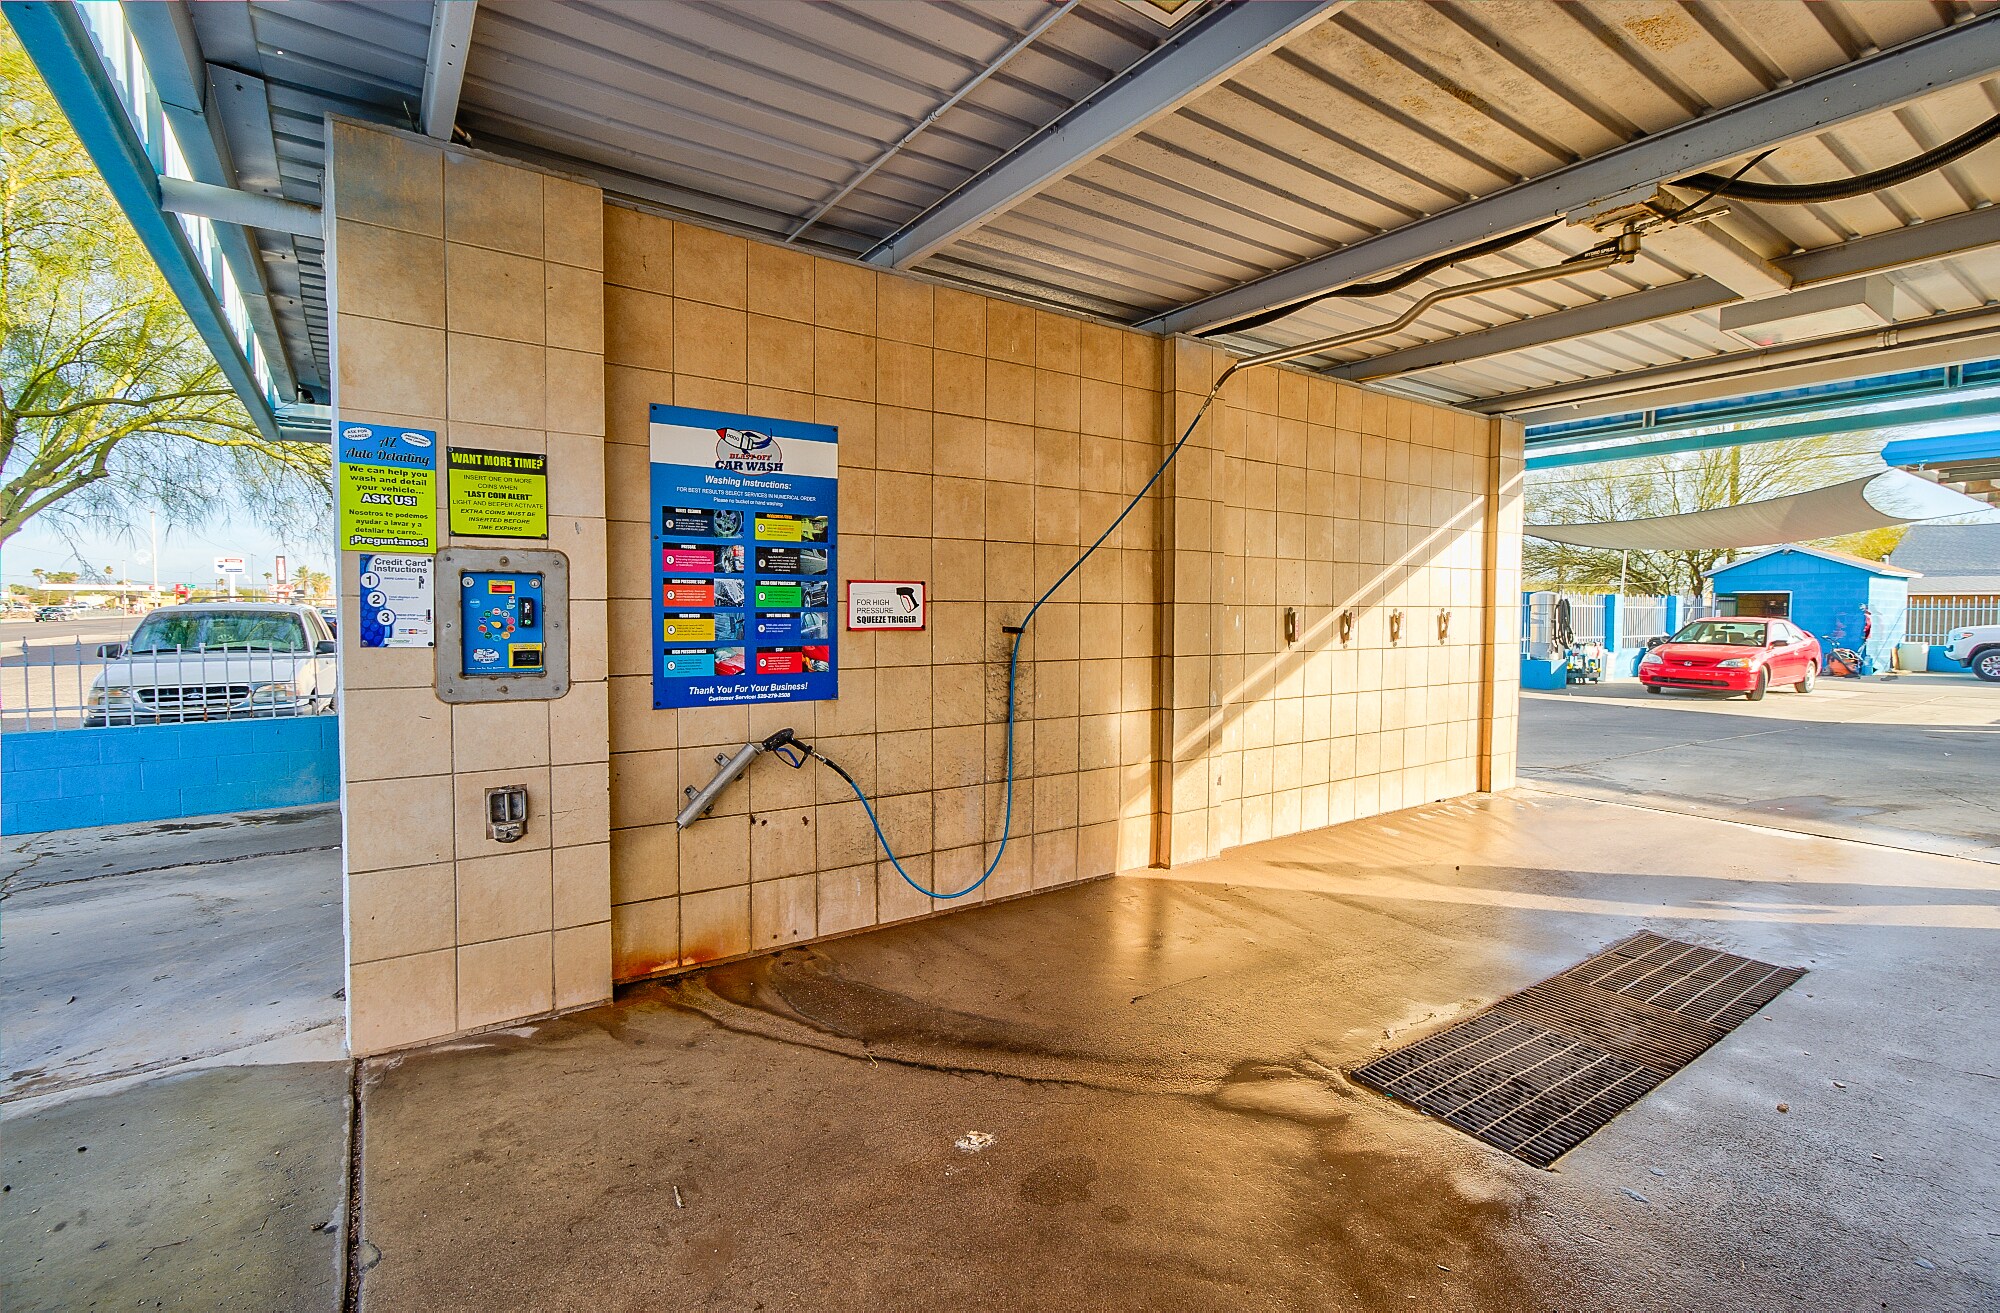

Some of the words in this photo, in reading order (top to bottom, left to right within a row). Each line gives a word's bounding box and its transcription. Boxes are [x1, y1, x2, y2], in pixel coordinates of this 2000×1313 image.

[345, 447, 373, 459] Auto
[377, 449, 430, 466] Detailing
[451, 452, 482, 465] WANT
[484, 455, 513, 467] MORE
[513, 458, 544, 470] TIME?
[715, 460, 743, 470] CAR
[746, 461, 784, 472] WASH
[388, 469, 408, 477] help
[705, 474, 741, 487] Washing
[742, 478, 792, 490] Instructions:
[382, 486, 424, 494] vehicle...
[744, 491, 768, 499] SERVICES
[361, 493, 392, 505] ASK
[393, 495, 417, 506] US!
[349, 509, 384, 517] Nosotros
[350, 535, 429, 547] ¡Preguntanos!
[375, 557, 403, 566] Credit
[405, 559, 427, 567] Card
[374, 565, 428, 573] Instructions
[366, 575, 372, 585] 1
[372, 594, 381, 605] 2
[381, 612, 390, 623] 3
[856, 615, 886, 624] SQUEEZE
[887, 615, 917, 624] TRIGGER
[689, 686, 715, 695] Thank
[717, 685, 733, 694] You
[734, 685, 748, 693] For
[750, 684, 769, 692] Your
[770, 682, 808, 691] Business!
